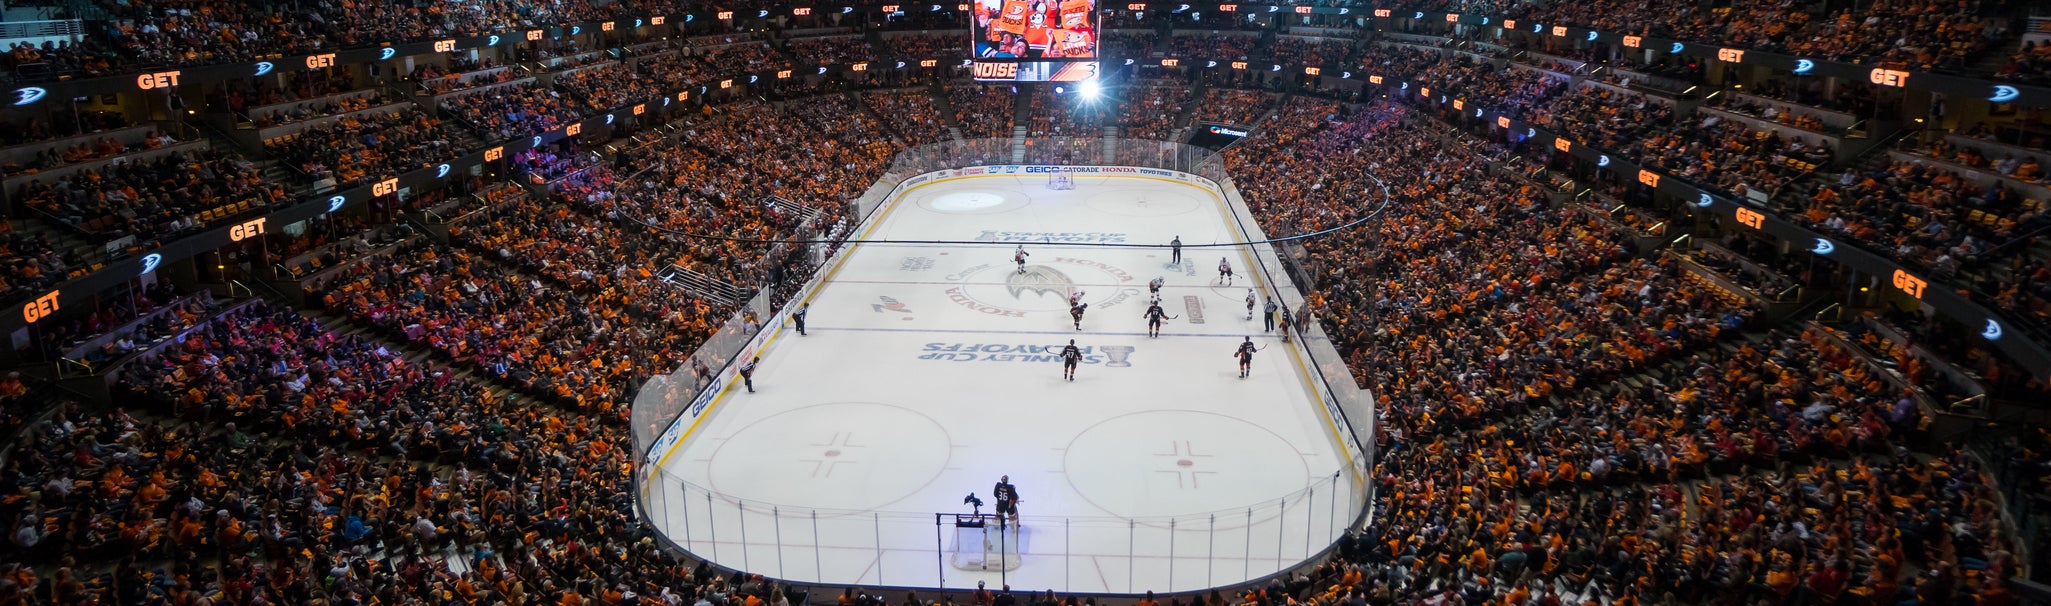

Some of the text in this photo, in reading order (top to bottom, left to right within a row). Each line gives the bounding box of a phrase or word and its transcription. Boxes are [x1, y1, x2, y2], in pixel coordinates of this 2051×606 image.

[1375, 9, 1391, 17] GET
[1446, 14, 1459, 22] GET
[602, 22, 614, 31] GET
[652, 16, 664, 25] GET
[1504, 20, 1515, 29] GET
[527, 30, 543, 40] GET
[1553, 26, 1567, 36] GET
[434, 40, 455, 52] GET
[1623, 36, 1641, 47] GET
[306, 53, 335, 68] GET
[1718, 48, 1744, 62] GET
[853, 63, 867, 71] GET
[974, 62, 1018, 78] NOISE
[1306, 67, 1320, 75] GET
[138, 71, 180, 89] GET
[778, 70, 791, 78] GET
[1370, 75, 1383, 84] GET
[1871, 68, 1909, 87] GET
[721, 80, 732, 88] GET
[678, 91, 688, 101] GET
[1421, 87, 1429, 97] GET
[634, 104, 645, 115] GET
[1454, 100, 1463, 110] GET
[1498, 116, 1510, 128] GET
[567, 123, 581, 136] GET
[1555, 138, 1571, 152] GET
[485, 146, 503, 161] GET
[1639, 170, 1660, 187] GET
[373, 178, 398, 196] GET
[1736, 207, 1765, 229] GET
[230, 218, 265, 241] GET
[1055, 256, 1134, 282] HONDA
[1893, 269, 1927, 299] GET
[24, 290, 59, 322] GET
[945, 286, 1027, 318] HONDA
[918, 352, 1104, 365] SANLEY CUP
[692, 377, 722, 418] GEICO
[1324, 389, 1344, 433] GEICO
[998, 491, 1008, 501] 36
